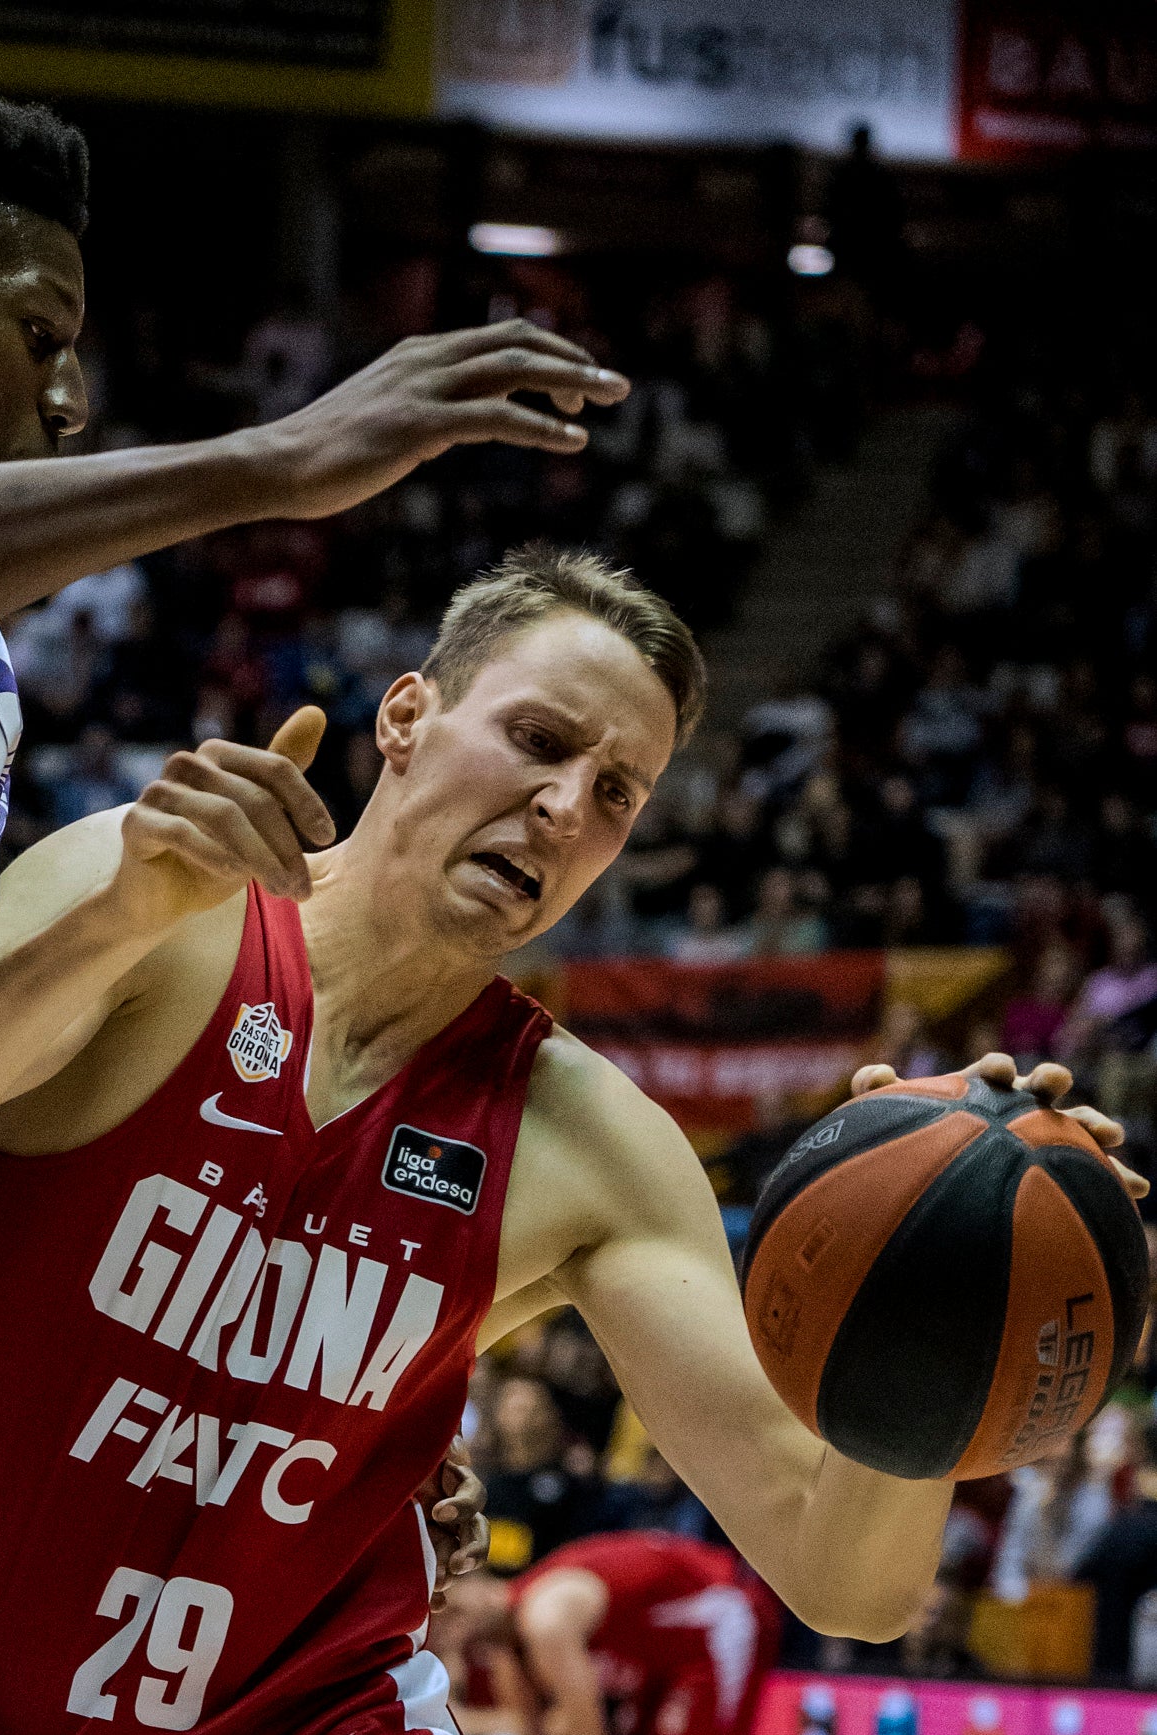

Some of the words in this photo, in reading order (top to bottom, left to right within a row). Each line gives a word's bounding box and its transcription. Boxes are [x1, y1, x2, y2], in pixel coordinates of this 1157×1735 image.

[229, 1032, 279, 1074] GIRONA
[398, 1147, 435, 1171] liga
[394, 1167, 472, 1203] endesa
[88, 1173, 444, 1411] GIRONA
[66, 1566, 234, 1731] 29
